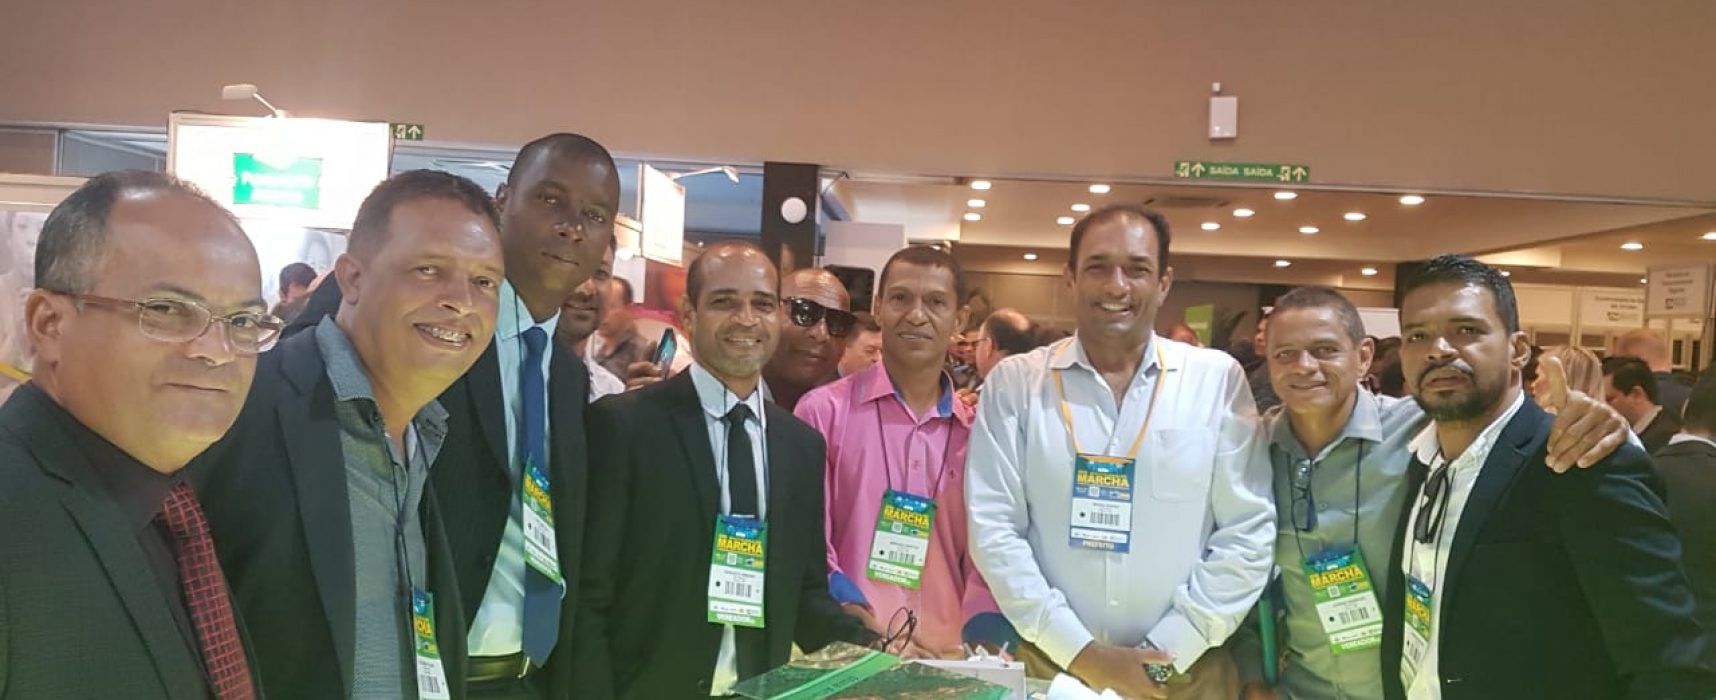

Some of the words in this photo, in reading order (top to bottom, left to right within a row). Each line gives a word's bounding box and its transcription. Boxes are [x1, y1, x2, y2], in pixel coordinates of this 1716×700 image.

[1077, 472, 1130, 488] MARCHA
[884, 506, 929, 529] MARCHA
[718, 537, 763, 555] MARCHA
[1311, 566, 1364, 590] MARCHA
